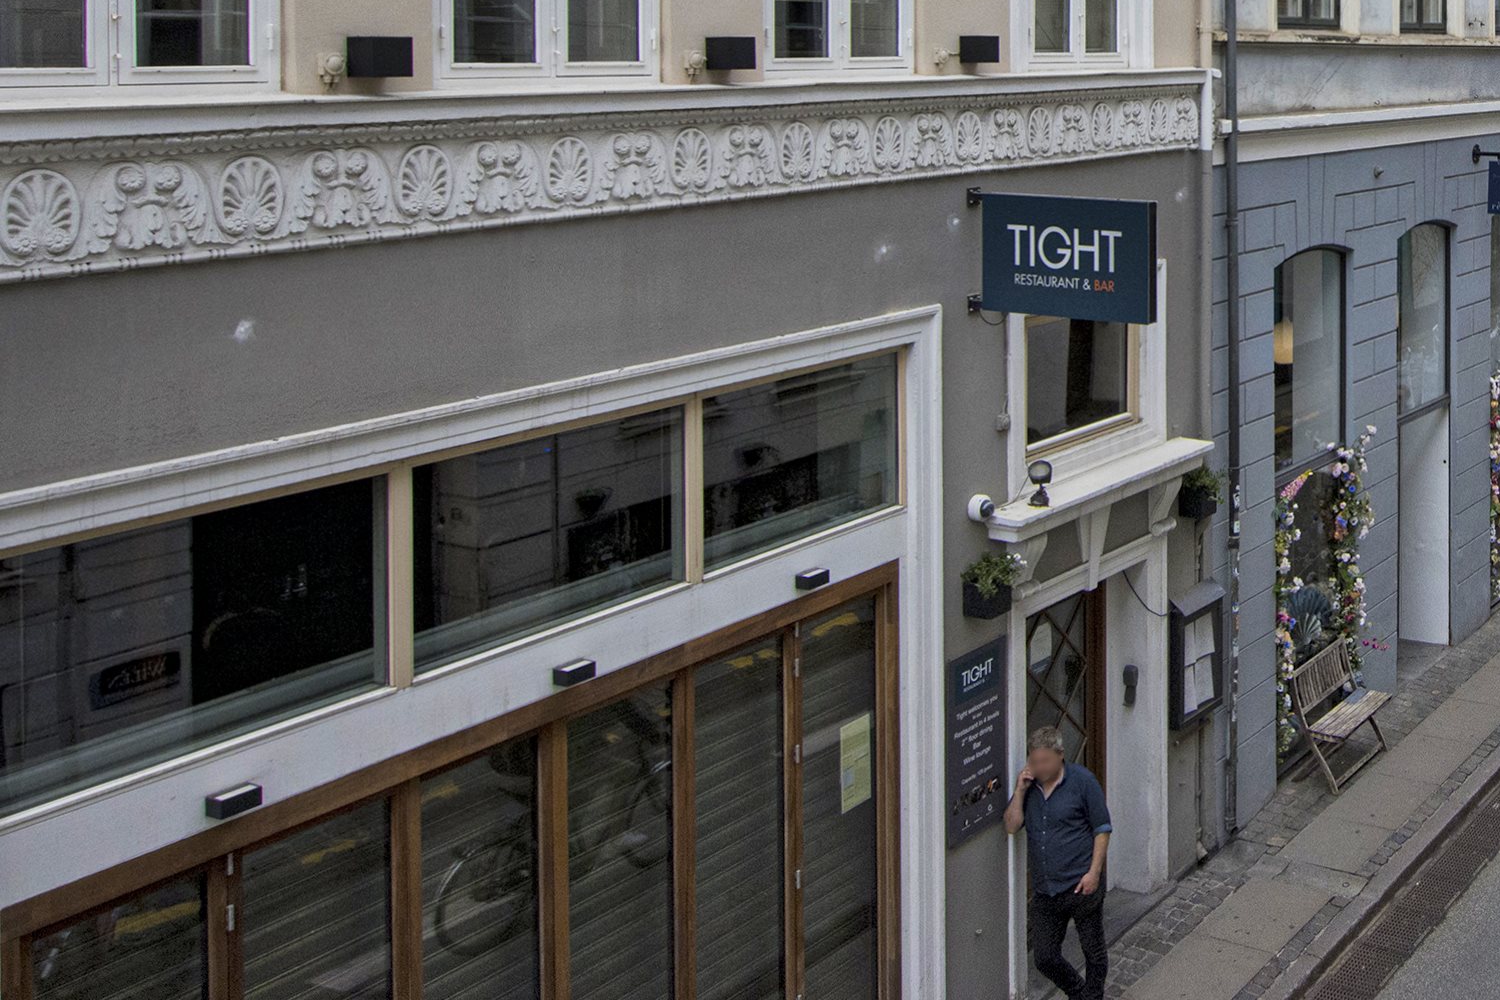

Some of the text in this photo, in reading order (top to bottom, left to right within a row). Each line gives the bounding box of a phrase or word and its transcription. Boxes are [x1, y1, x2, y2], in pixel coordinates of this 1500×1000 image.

[1007, 224, 1122, 273] TIGHT
[1014, 273, 1115, 293] RESTAURANT & BAR
[961, 657, 994, 687] TIGHT
